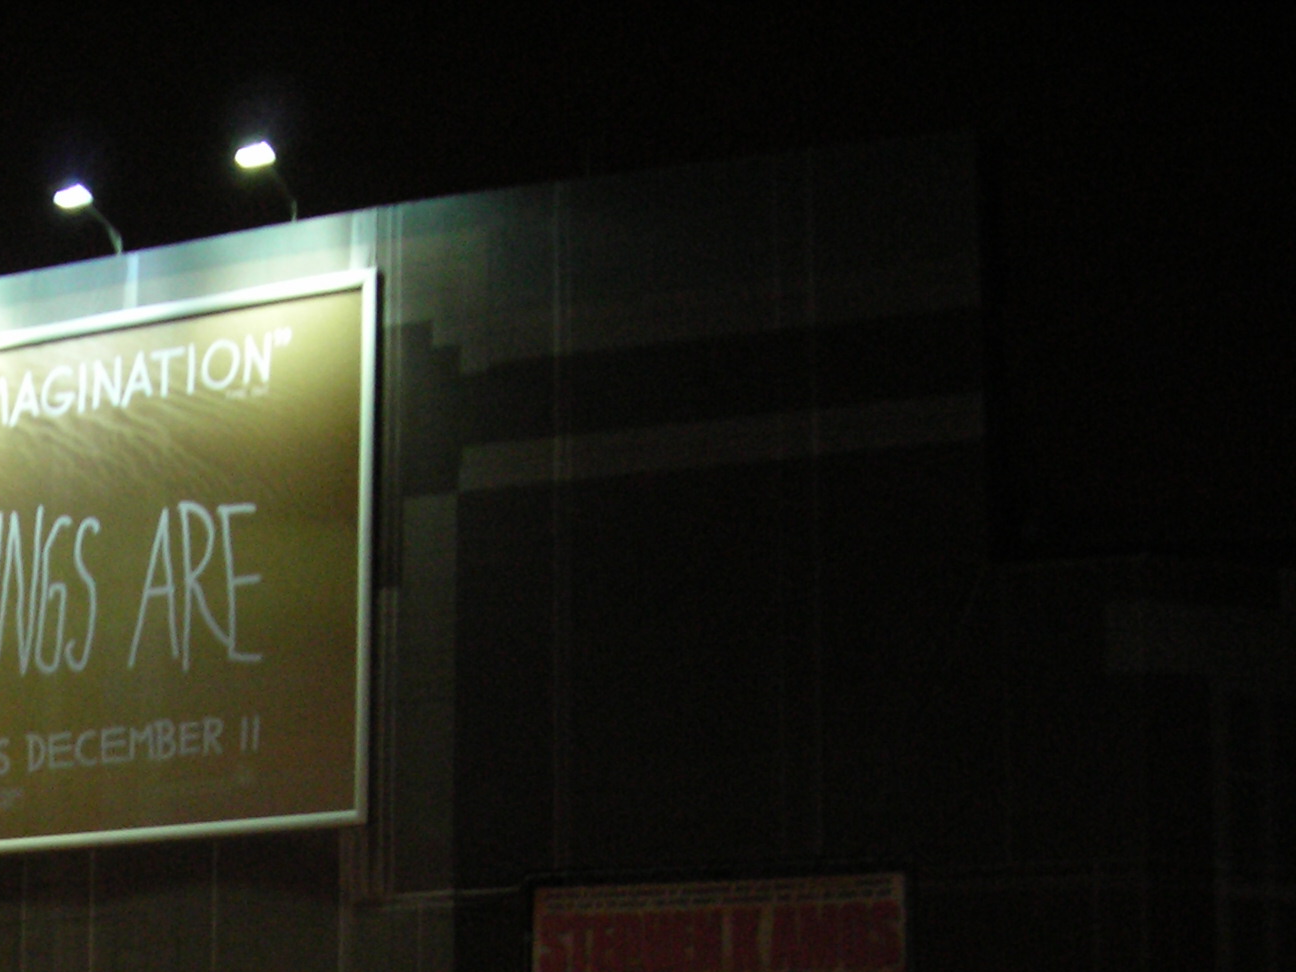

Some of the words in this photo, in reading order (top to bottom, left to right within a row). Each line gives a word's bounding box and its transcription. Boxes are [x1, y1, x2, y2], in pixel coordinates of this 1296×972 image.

[127, 500, 262, 673] ARE
[25, 717, 225, 773] DECEMBER
[240, 714, 262, 752] 11
